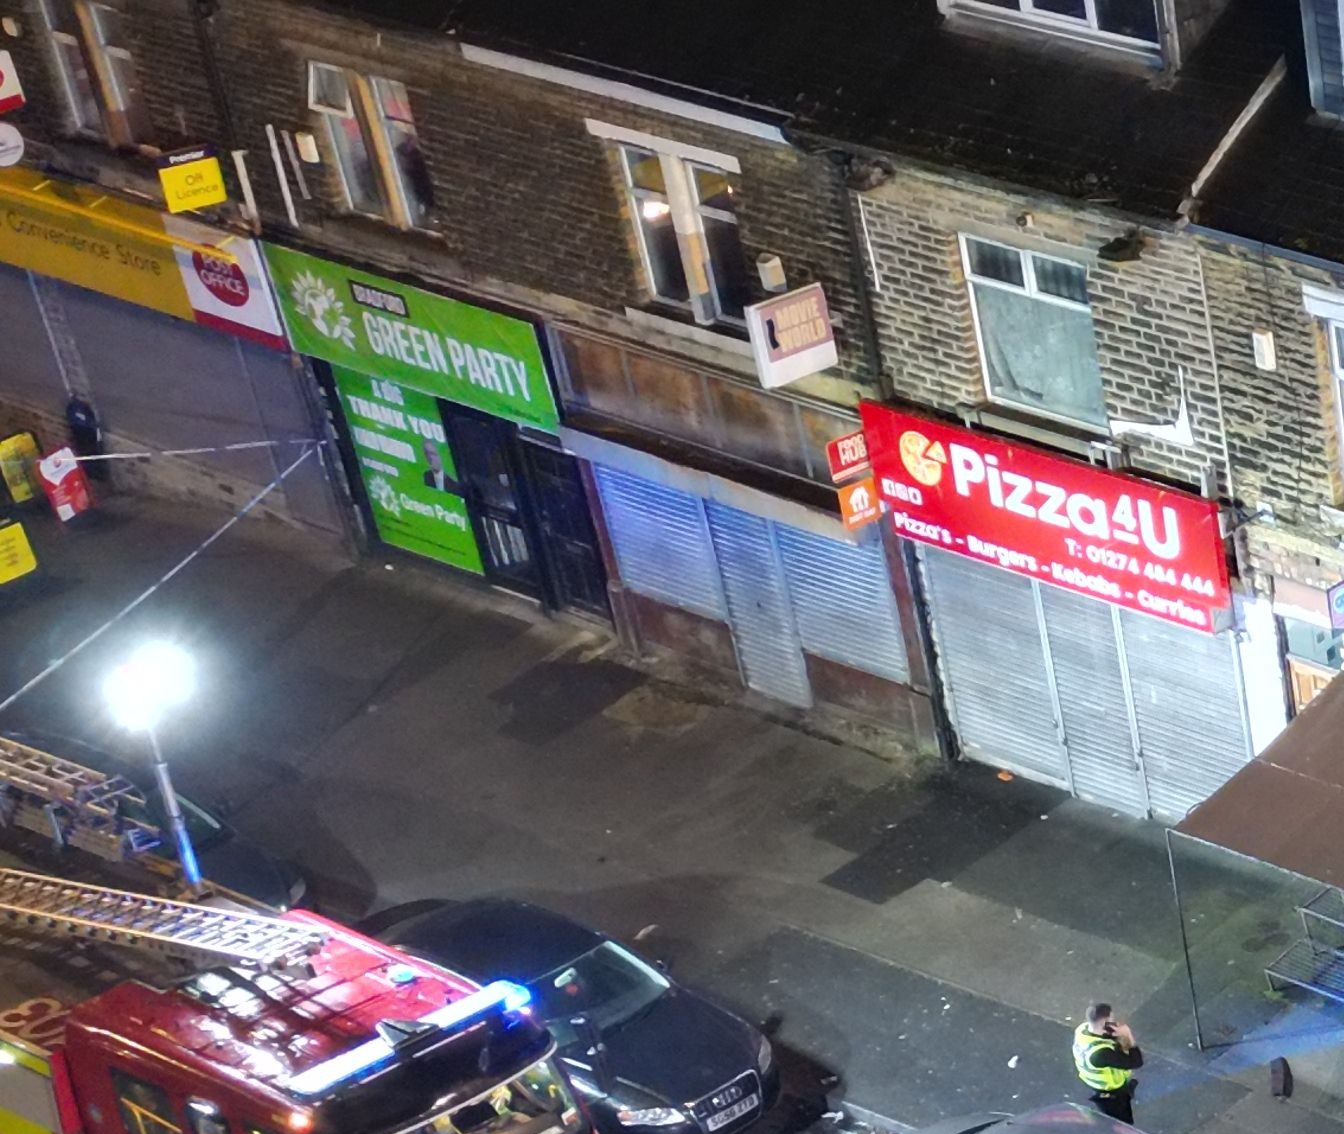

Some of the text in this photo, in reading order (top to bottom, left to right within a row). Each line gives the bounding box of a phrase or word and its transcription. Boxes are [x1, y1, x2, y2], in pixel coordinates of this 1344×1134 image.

[169, 151, 204, 164] Premier
[175, 183, 219, 200] Licence
[6, 210, 162, 276] Convenience Store
[202, 252, 236, 274] POST
[200, 269, 247, 296] OFFICE
[775, 297, 819, 326] MOVIE
[777, 318, 827, 353] WORLD
[362, 311, 532, 402] GREEN PARTY
[346, 394, 446, 443] THANK YOU
[837, 432, 864, 451] FOOD
[839, 441, 868, 466] HUB
[400, 493, 466, 532] Green Party
[949, 443, 1181, 560] Pizza4U
[893, 511, 952, 545] Pizza's
[966, 534, 1039, 572] Burgers
[1051, 562, 1121, 598] Kebabs
[1064, 537, 1082, 558] T:
[1086, 545, 1140, 575] 01274
